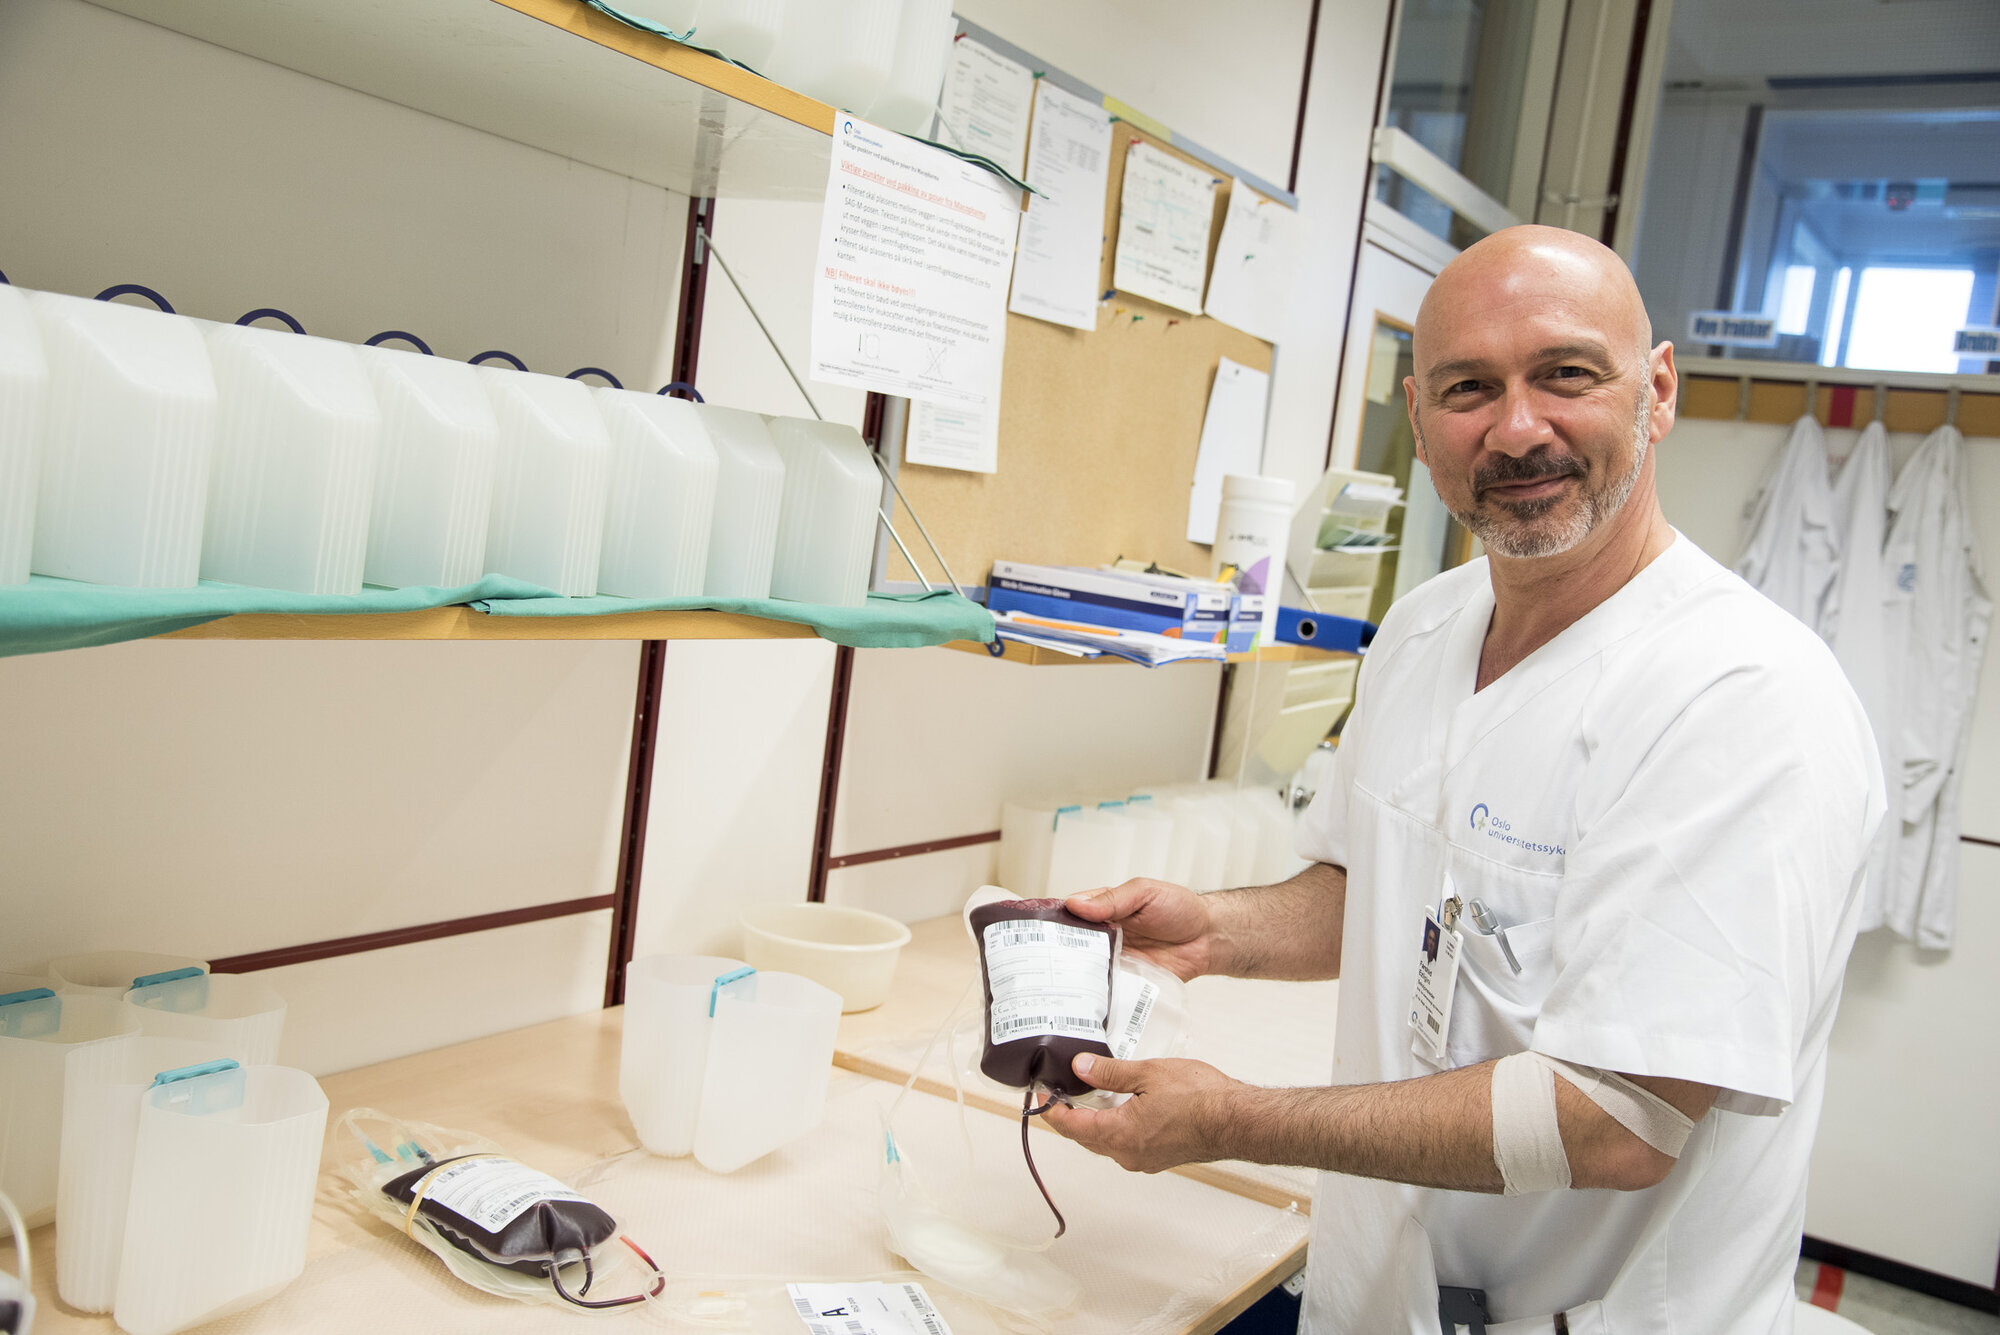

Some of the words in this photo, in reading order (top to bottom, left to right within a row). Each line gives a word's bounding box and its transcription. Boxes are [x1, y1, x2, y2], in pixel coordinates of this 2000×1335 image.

[840, 159, 861, 176] Viktige
[862, 167, 885, 185] punkter
[886, 175, 896, 187] ved
[897, 179, 919, 197] pakking
[920, 189, 927, 198] av
[928, 192, 944, 206] poser
[847, 183, 865, 196] Filteret
[865, 189, 874, 199] skal
[839, 237, 857, 249] Filteret
[858, 242, 867, 252] skal
[838, 269, 862, 283] Filteret
[863, 275, 875, 286] skal
[877, 279, 890, 290] ikke
[847, 287, 865, 298] filteret
[1491, 816, 1511, 831] Oslo
[1049, 1020, 1054, 1030] 1
[821, 1307, 849, 1317] A
